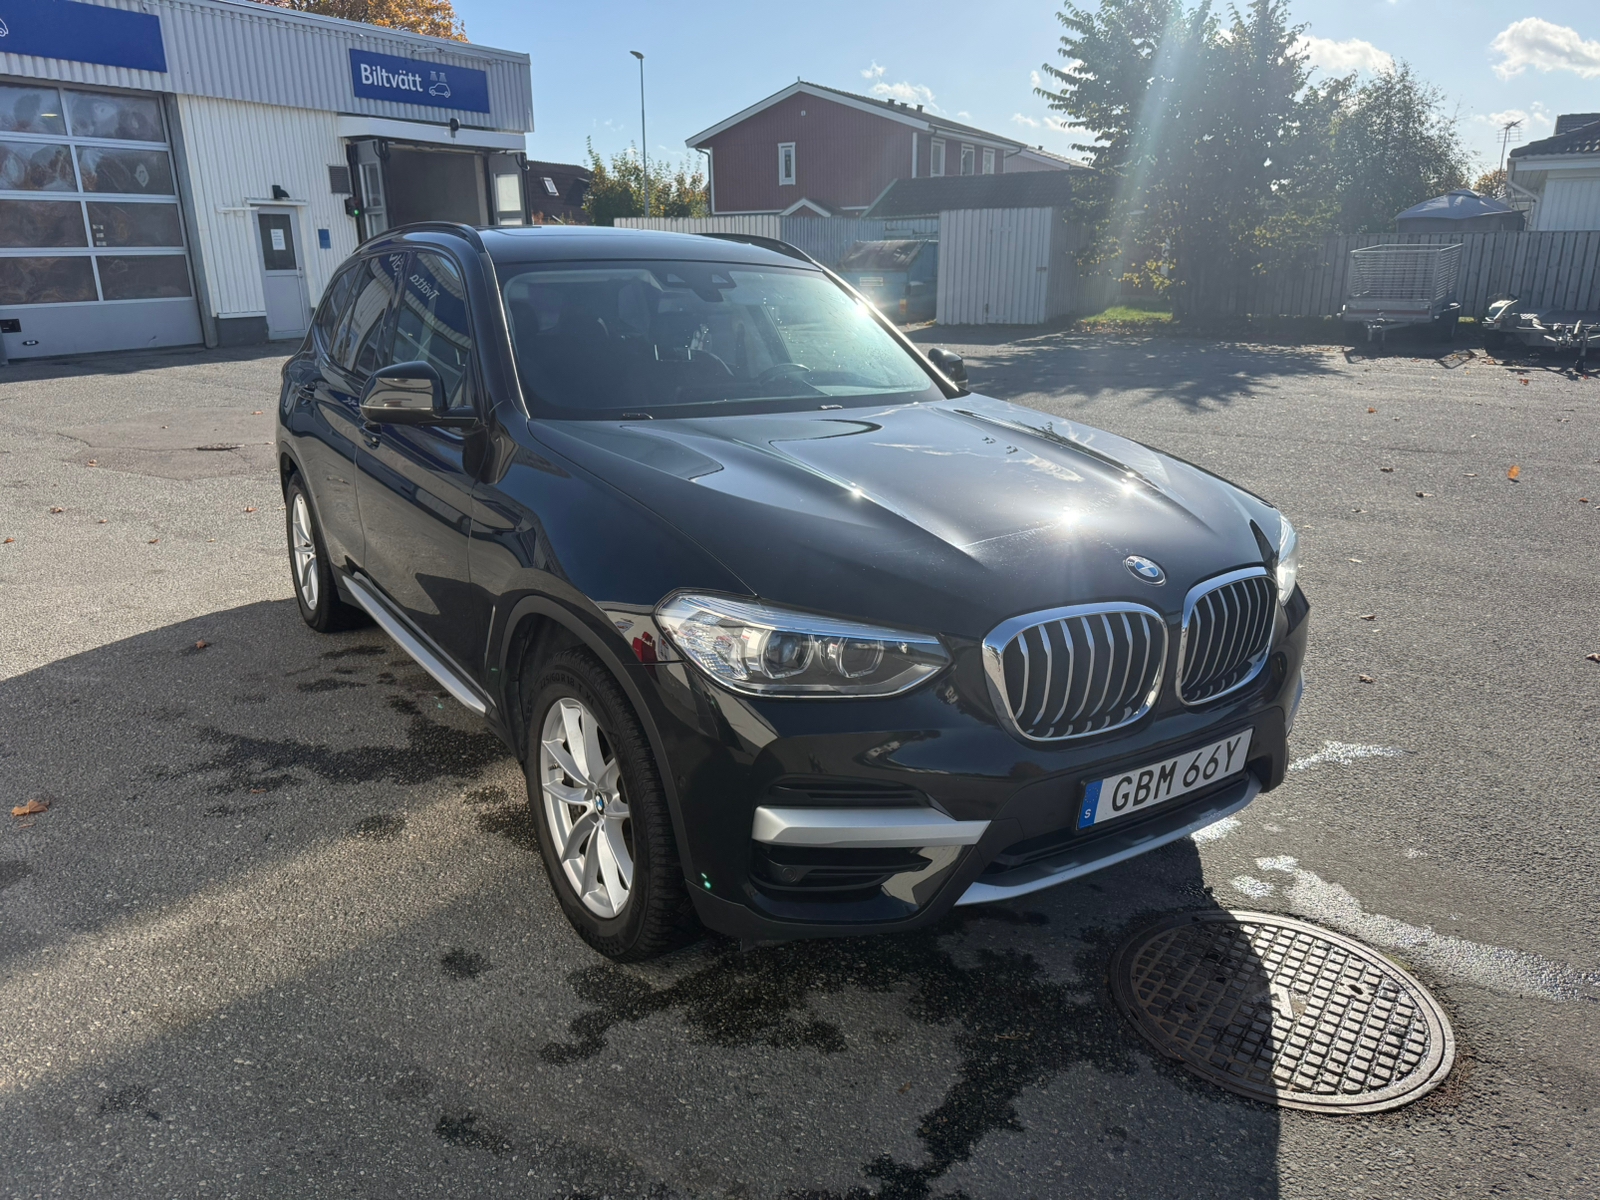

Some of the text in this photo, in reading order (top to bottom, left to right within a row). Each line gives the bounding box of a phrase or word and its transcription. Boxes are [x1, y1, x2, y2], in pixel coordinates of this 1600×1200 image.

[360, 63, 424, 92] Biltvätt
[1112, 737, 1242, 812] GBM 66Y
[1084, 808, 1092, 819] S
